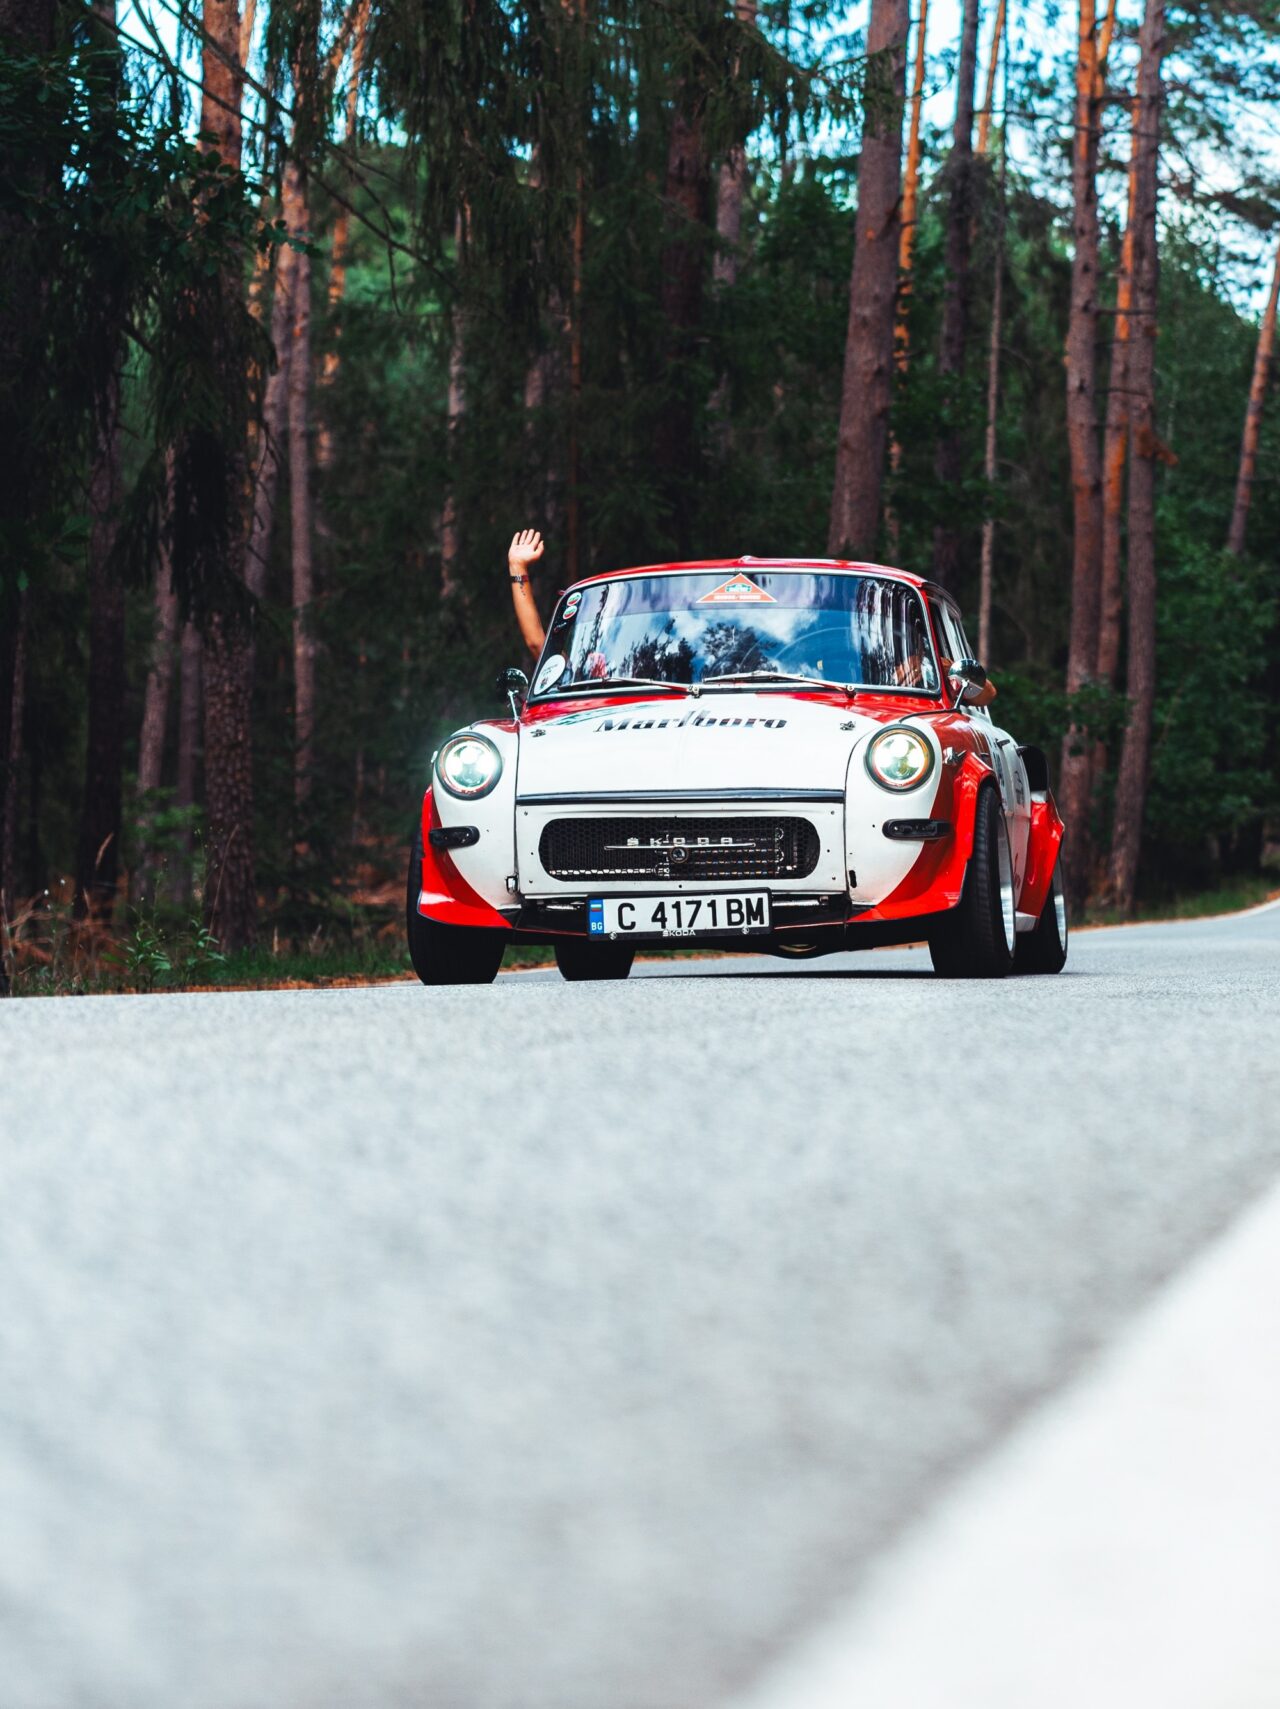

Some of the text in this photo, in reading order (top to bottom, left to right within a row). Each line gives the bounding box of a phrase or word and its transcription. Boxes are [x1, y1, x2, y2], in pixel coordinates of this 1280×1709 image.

[593, 709, 789, 733] Marlboro
[590, 921, 604, 932] BG
[617, 902, 637, 931] C
